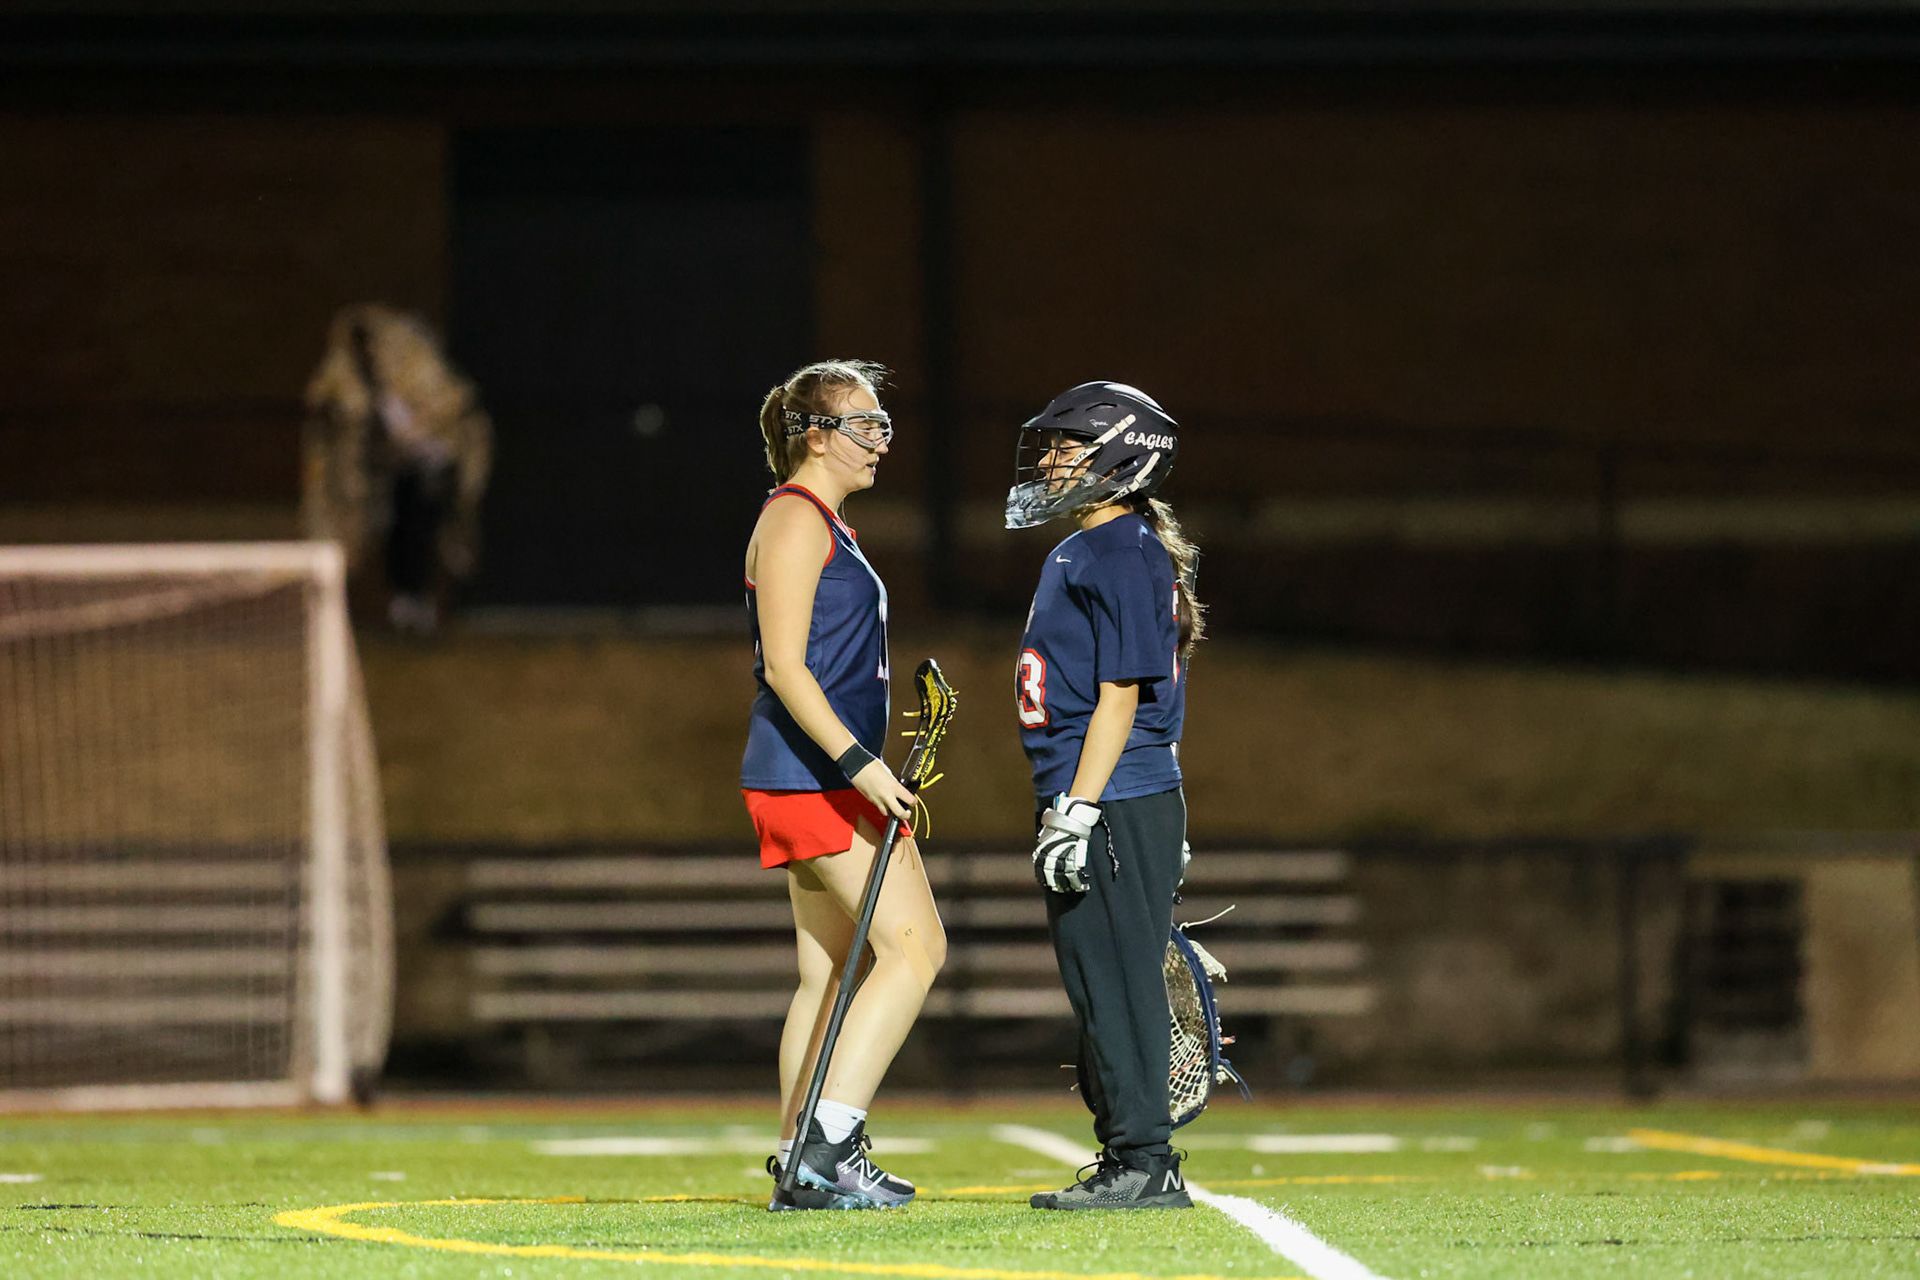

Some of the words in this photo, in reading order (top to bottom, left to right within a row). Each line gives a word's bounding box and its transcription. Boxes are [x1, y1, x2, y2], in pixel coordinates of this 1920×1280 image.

[786, 411, 802, 421] STX
[810, 415, 838, 425] STX
[788, 424, 804, 434] STX
[1124, 431, 1173, 450] EAGLES
[1073, 451, 1088, 465] STX
